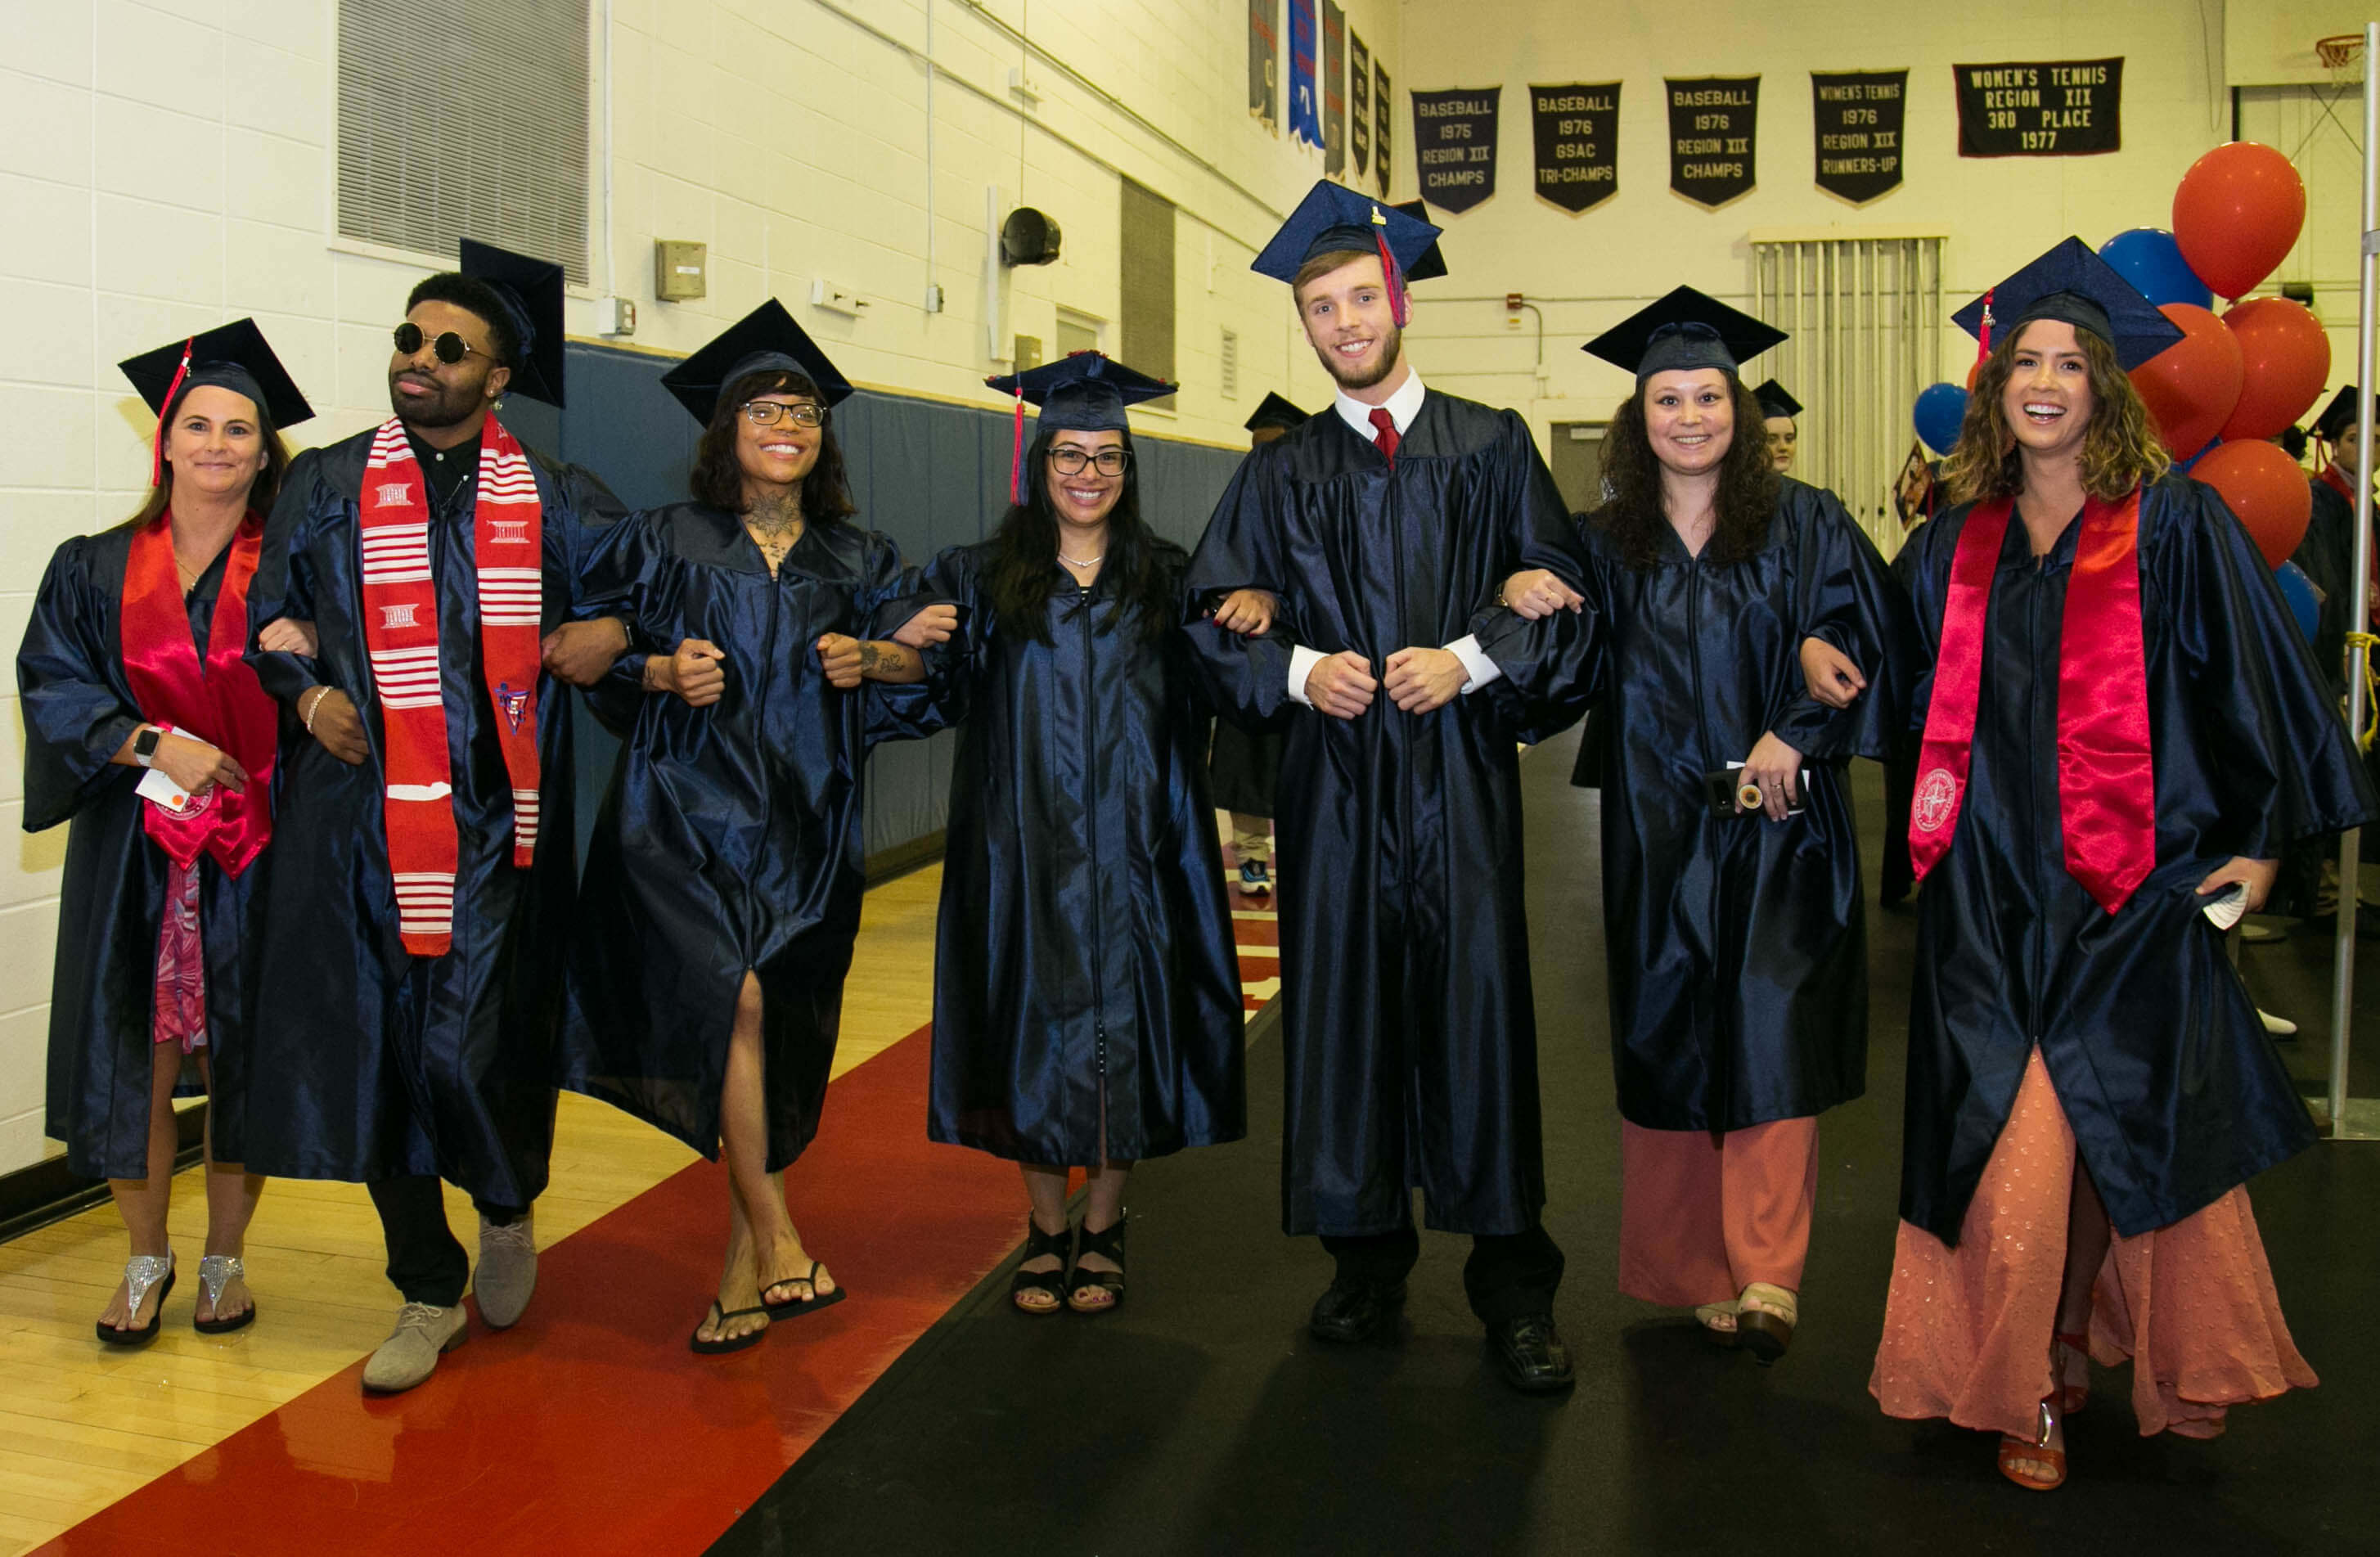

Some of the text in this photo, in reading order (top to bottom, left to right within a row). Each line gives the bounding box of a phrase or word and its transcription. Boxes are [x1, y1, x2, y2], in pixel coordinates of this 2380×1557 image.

[1971, 66, 2107, 88] WOMEN'S TENNIS
[1673, 90, 1752, 106] BASEBALL
[1865, 83, 1900, 99] TENNIS
[1986, 88, 2091, 109] REGION XIX
[1419, 101, 1492, 117] BASEBALL
[1538, 96, 1614, 112] BASEBALL
[1694, 115, 1730, 130] 1976
[1842, 109, 1878, 125] 1976
[1988, 109, 2091, 128] 3RD PLACE
[1559, 119, 1593, 135] 1976
[1676, 137, 1749, 155] REGION XIX
[1822, 132, 1896, 150] REGION XIX
[2022, 131, 2057, 150] 1977
[1422, 146, 1490, 164] REGION XIX
[1556, 143, 1596, 159] GSAC
[1684, 163, 1743, 178] CHAMPS
[1822, 156, 1897, 174] RUNNERS-UP
[1428, 171, 1484, 187] CHAMPS
[1539, 165, 1613, 183] TRI-CHAMPS
